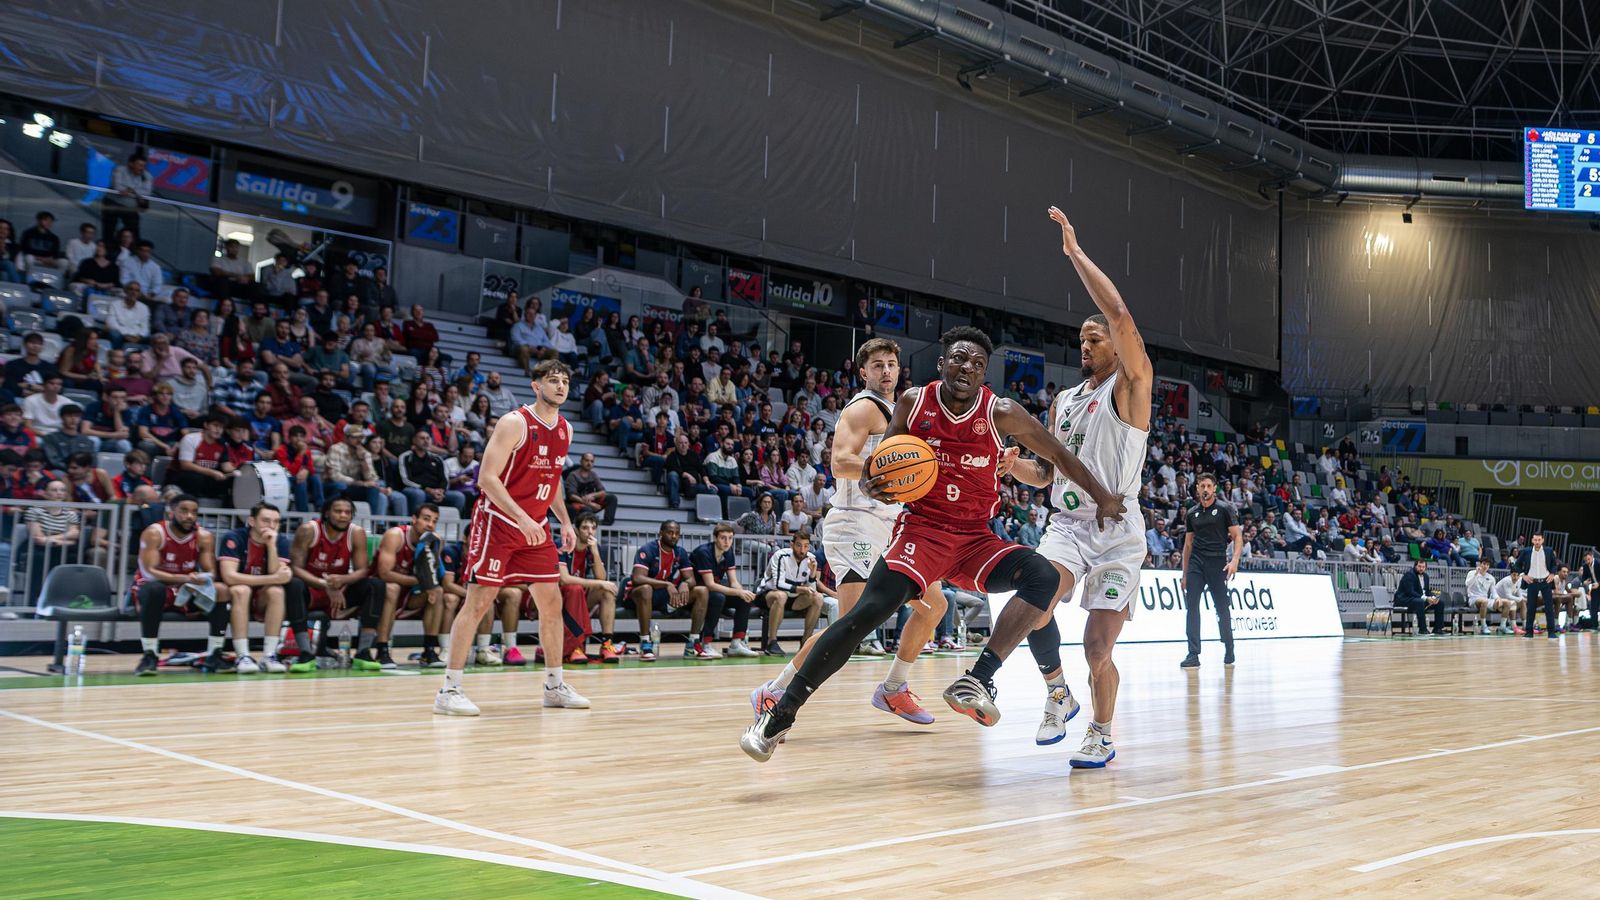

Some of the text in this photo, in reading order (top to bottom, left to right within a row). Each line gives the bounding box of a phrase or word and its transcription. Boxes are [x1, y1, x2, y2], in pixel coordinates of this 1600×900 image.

[235, 171, 318, 205] Salida
[331, 180, 354, 210] 9
[1583, 184, 1593, 197] 2
[409, 202, 441, 217] Sector
[551, 288, 598, 308] Sector
[730, 273, 762, 304] 24
[768, 280, 833, 306] Salida 10
[643, 304, 685, 323] Sector
[1004, 349, 1031, 364] Sector
[874, 450, 920, 469] Wilson
[1525, 461, 1575, 480] olivo
[535, 483, 551, 501] 10
[946, 483, 961, 502] 9
[904, 542, 916, 556] 9
[488, 558, 501, 572] 10
